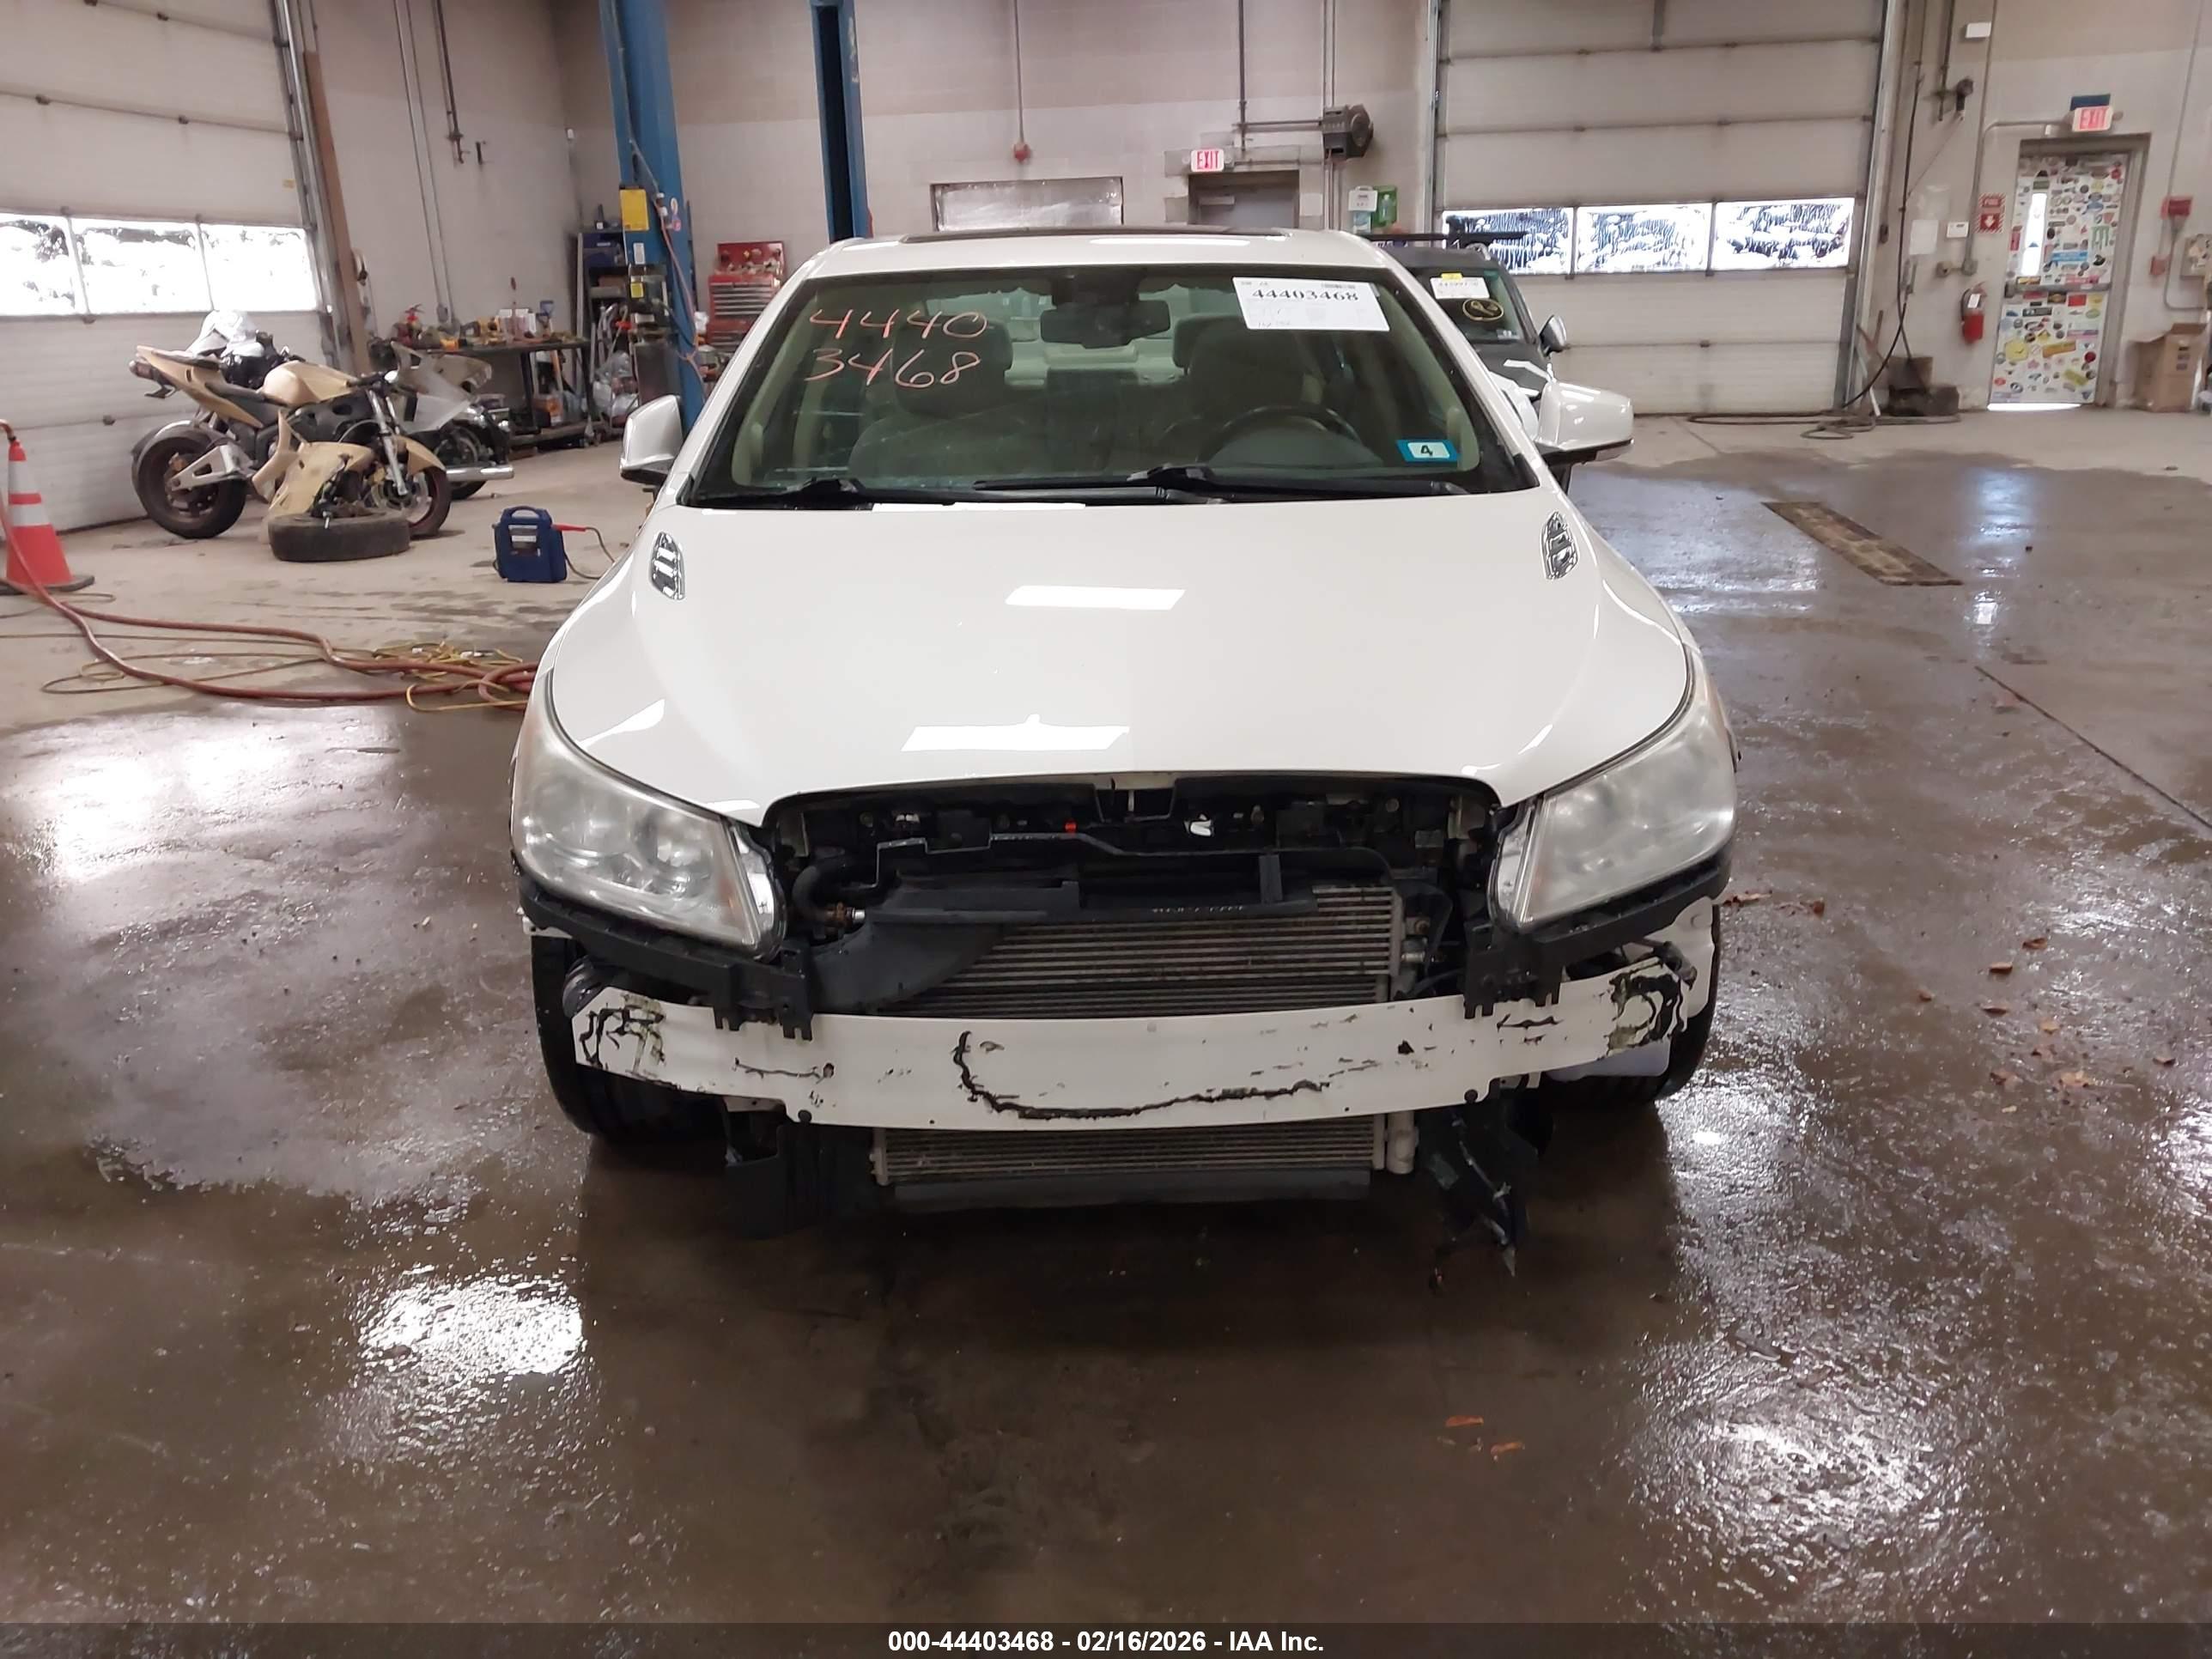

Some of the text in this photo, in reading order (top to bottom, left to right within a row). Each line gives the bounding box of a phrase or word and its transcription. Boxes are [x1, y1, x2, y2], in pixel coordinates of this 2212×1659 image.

[2080, 108, 2109, 130] EXIT
[1196, 150, 1219, 170] EXIT
[1251, 288, 1359, 301] 44403468
[809, 308, 989, 339] 4440
[804, 347, 981, 388] 3468
[1420, 445, 1433, 456] 4
